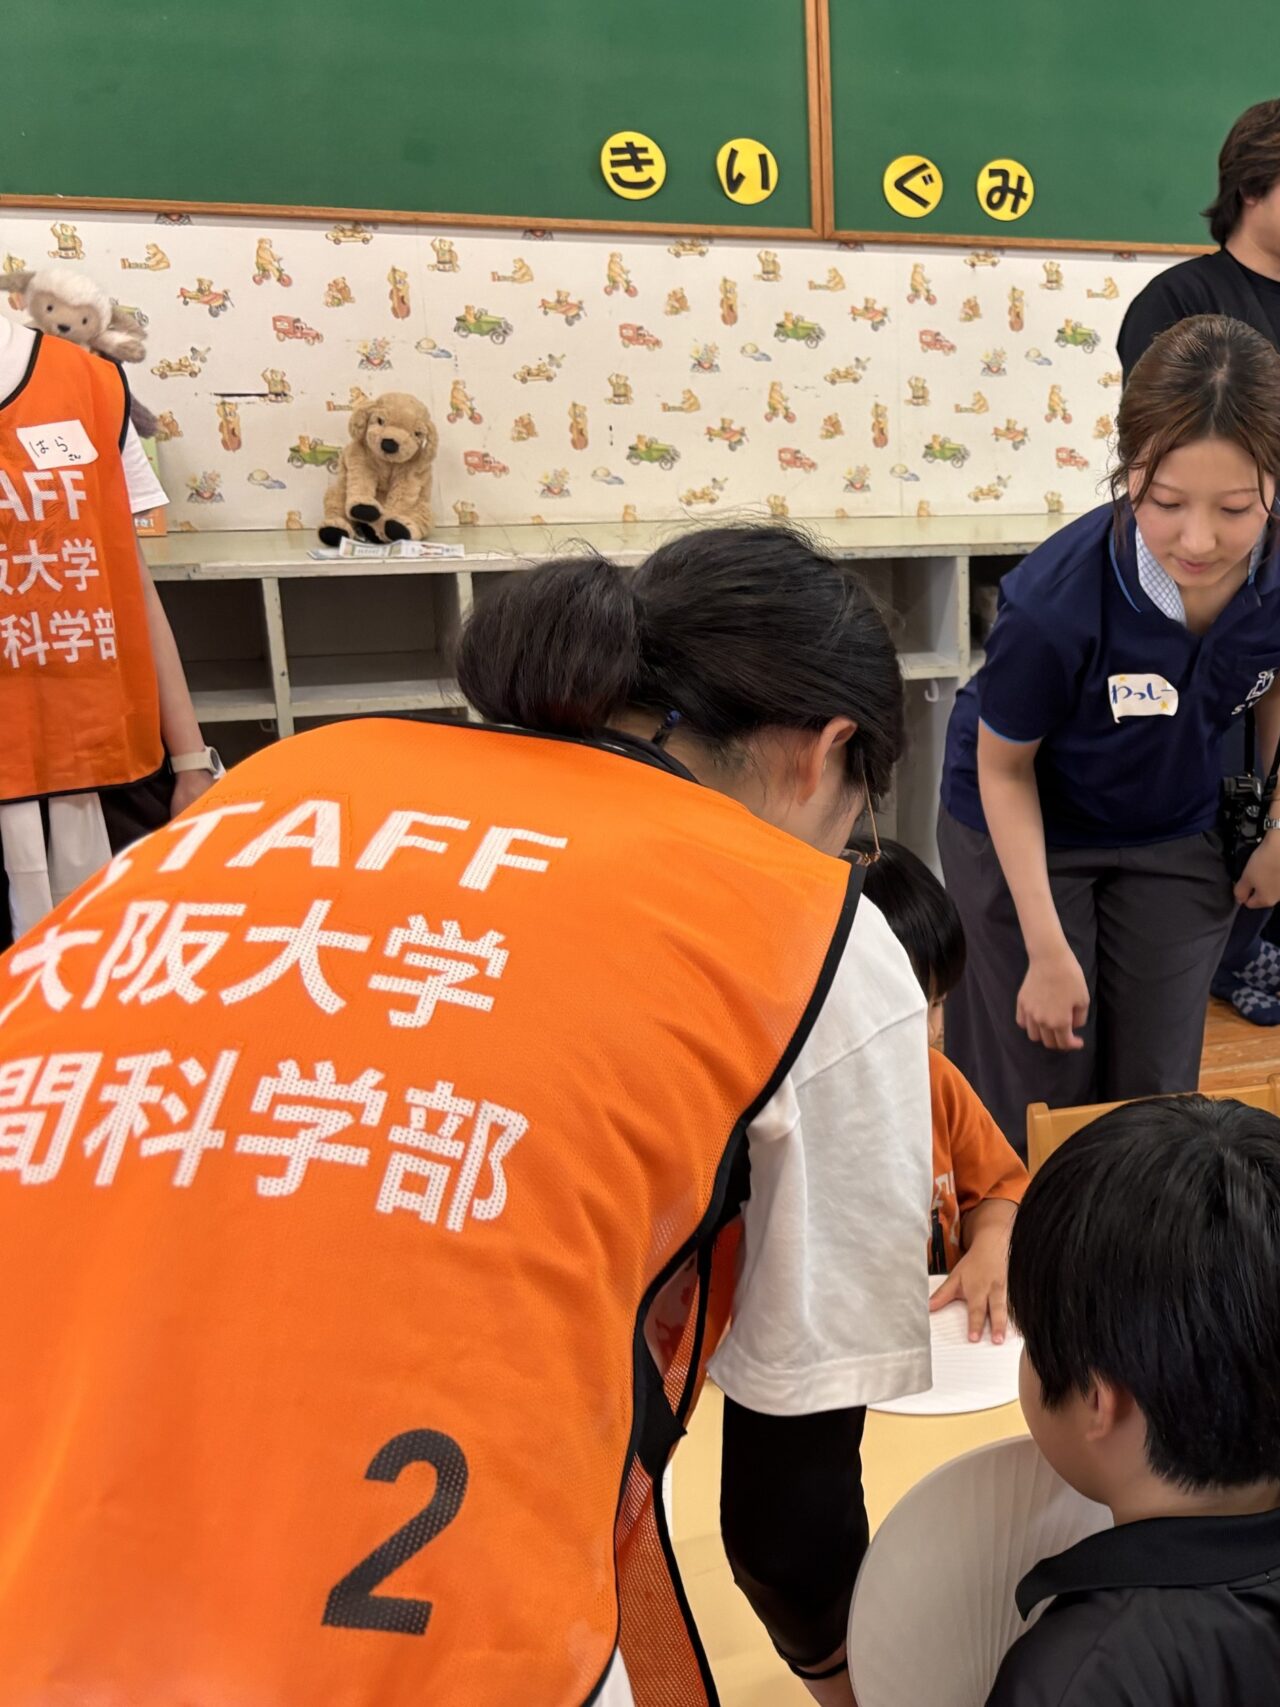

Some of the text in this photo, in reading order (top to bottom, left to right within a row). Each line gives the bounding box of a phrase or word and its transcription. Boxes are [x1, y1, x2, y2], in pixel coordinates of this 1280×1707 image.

[0, 538, 99, 595] 大学
[0, 899, 510, 1029] 大阪大学
[321, 1427, 469, 1636] 2
